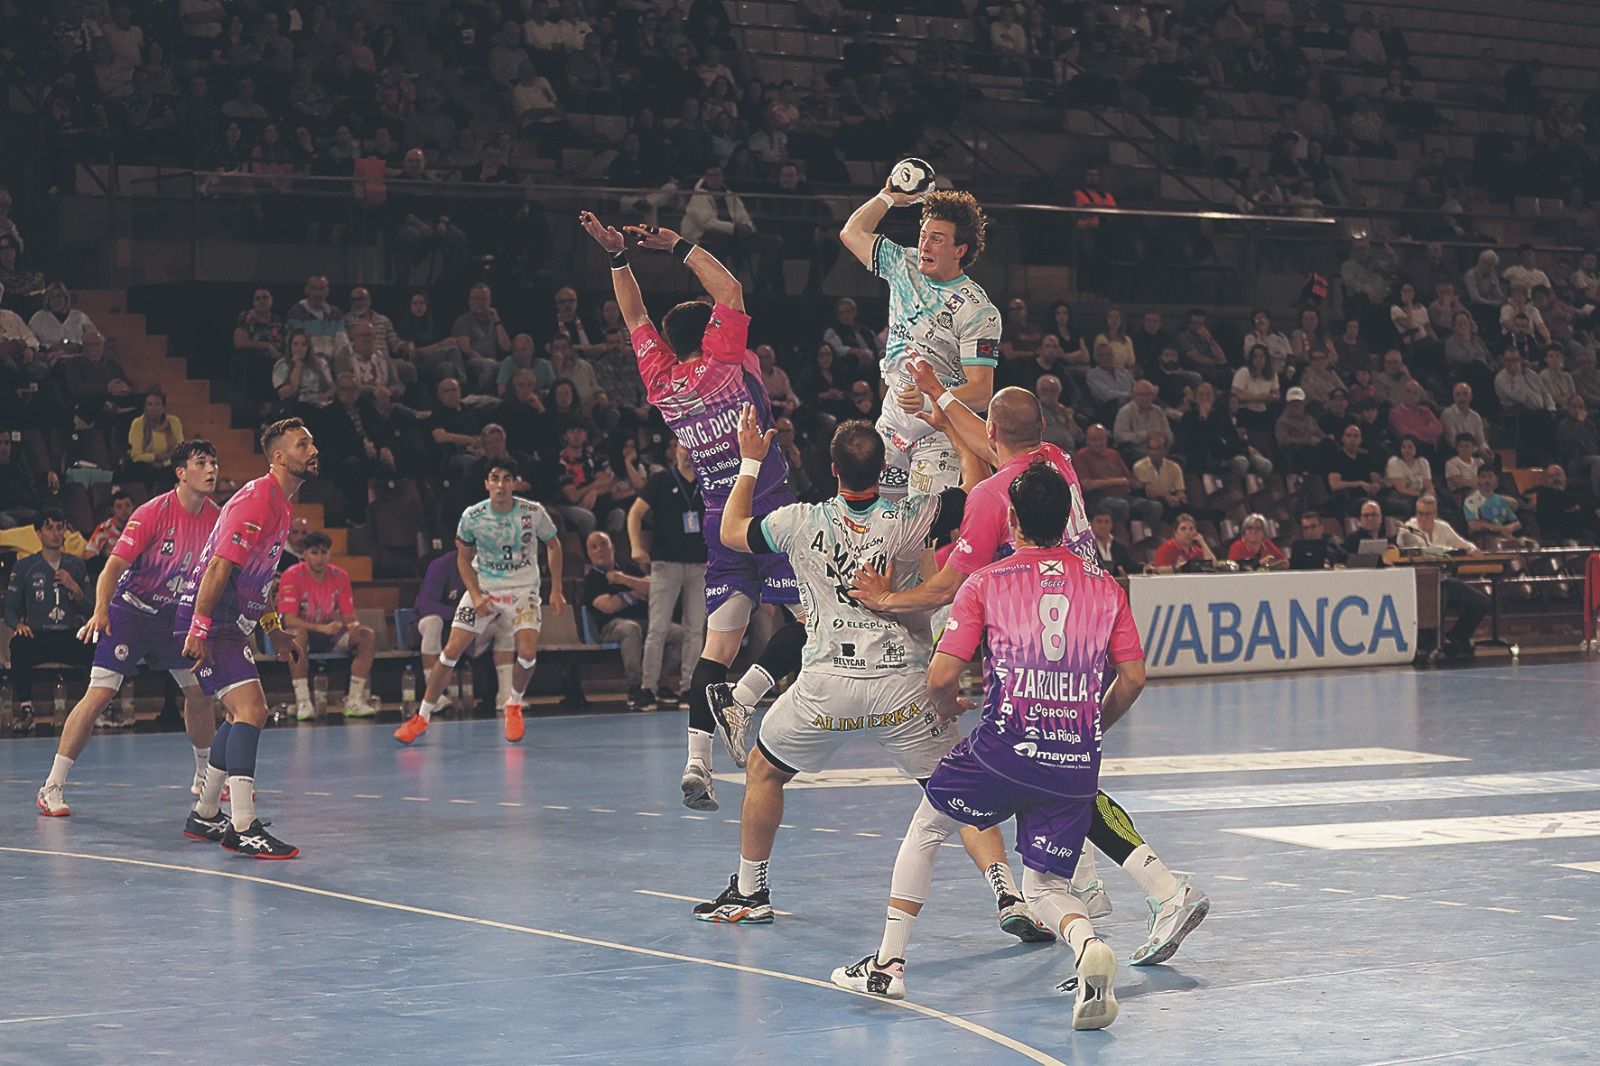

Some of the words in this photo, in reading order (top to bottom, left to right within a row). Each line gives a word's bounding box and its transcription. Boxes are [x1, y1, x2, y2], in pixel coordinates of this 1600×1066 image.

[706, 465, 718, 474] La
[717, 457, 740, 472] Rioja
[502, 545, 512, 560] 3
[180, 551, 193, 572] 9
[1038, 592, 1070, 662] 8
[1165, 594, 1408, 667] ABANCA
[833, 657, 866, 667] BELYCAR
[1012, 667, 1089, 702] ZARZUELA
[812, 702, 921, 731] ALIMERKA
[1029, 702, 1078, 719] LOGROÑO
[1042, 729, 1056, 741] La
[1057, 729, 1081, 744] Rioja
[1036, 751, 1090, 764] mayoral
[1045, 841, 1057, 855] La
